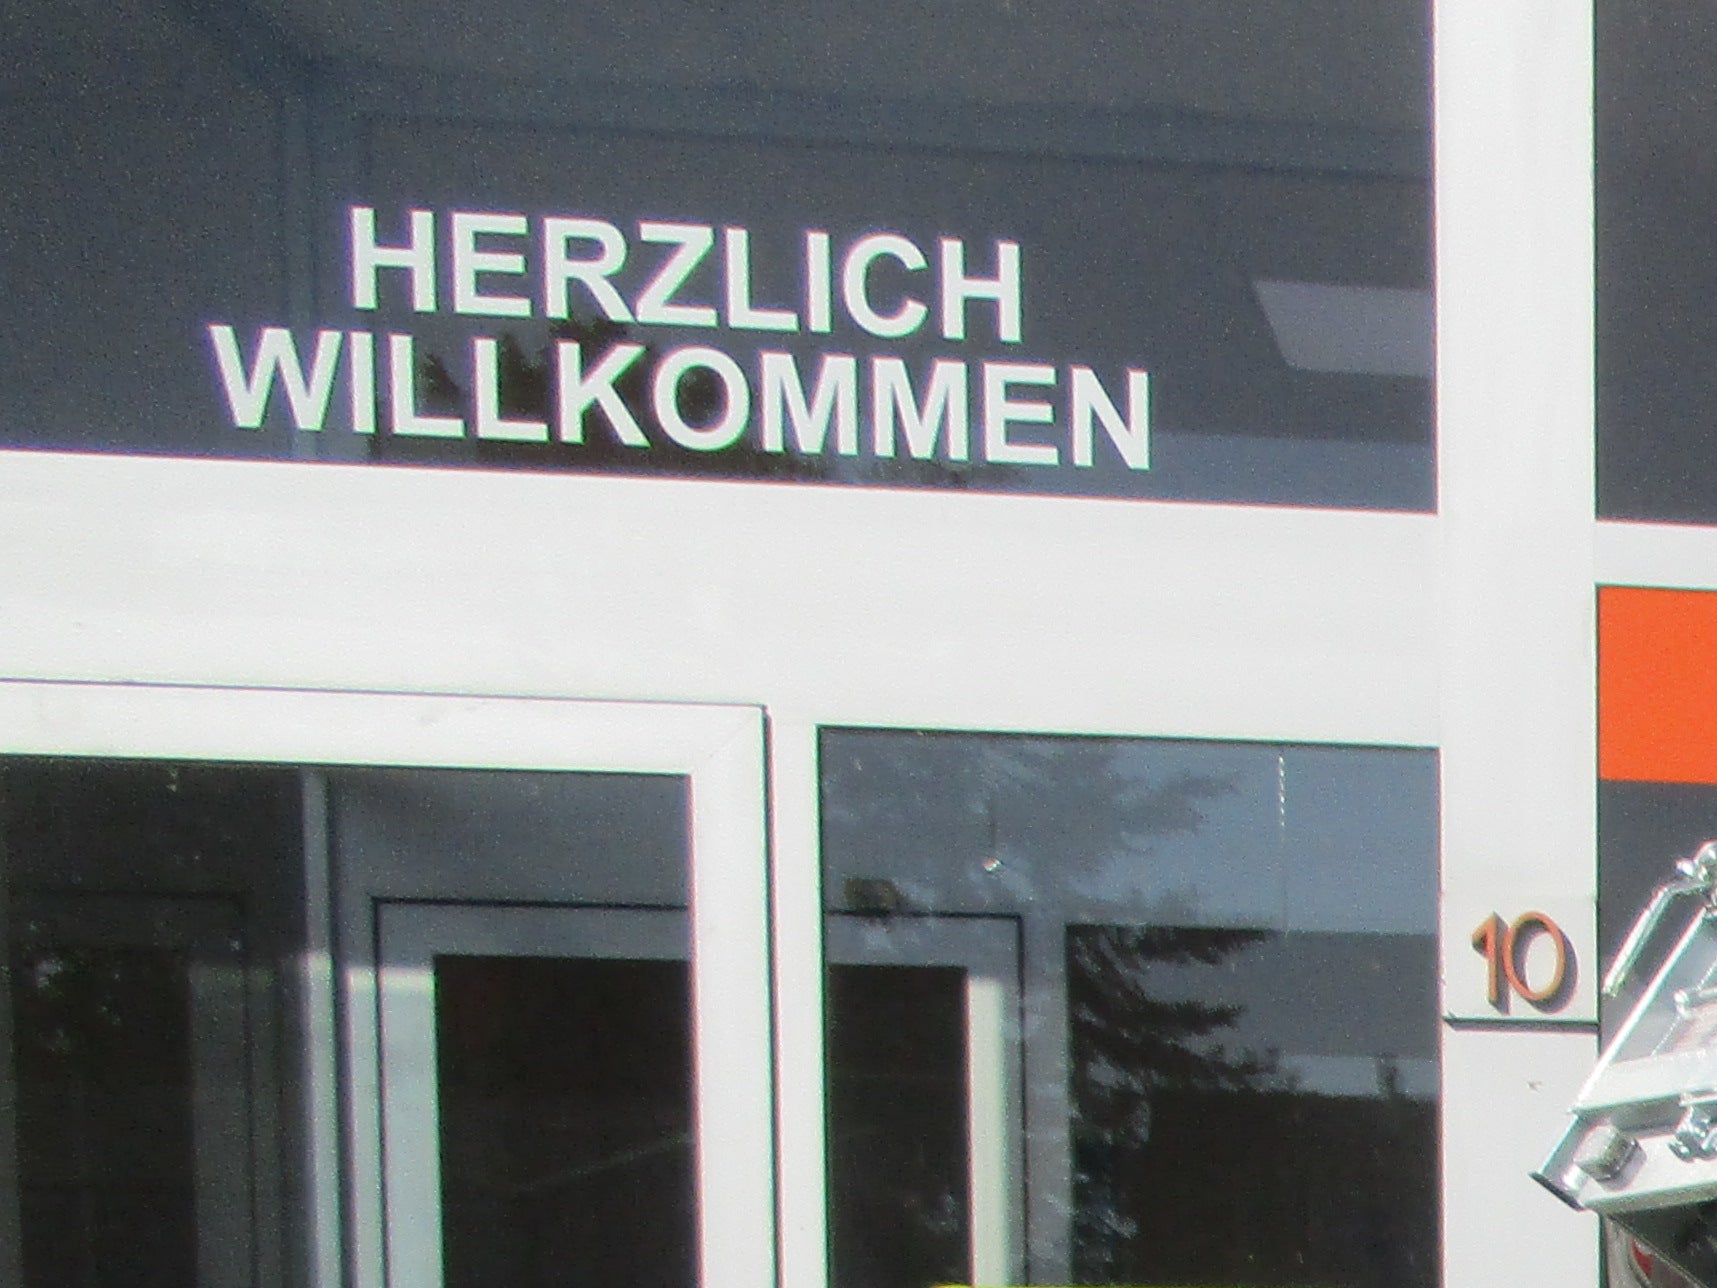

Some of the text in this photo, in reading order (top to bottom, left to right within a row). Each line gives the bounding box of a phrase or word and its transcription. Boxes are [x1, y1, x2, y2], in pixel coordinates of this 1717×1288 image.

[349, 206, 1024, 343] HERZLICH
[210, 323, 1152, 472] WILLKOMMEN
[1471, 910, 1567, 1006] 10
